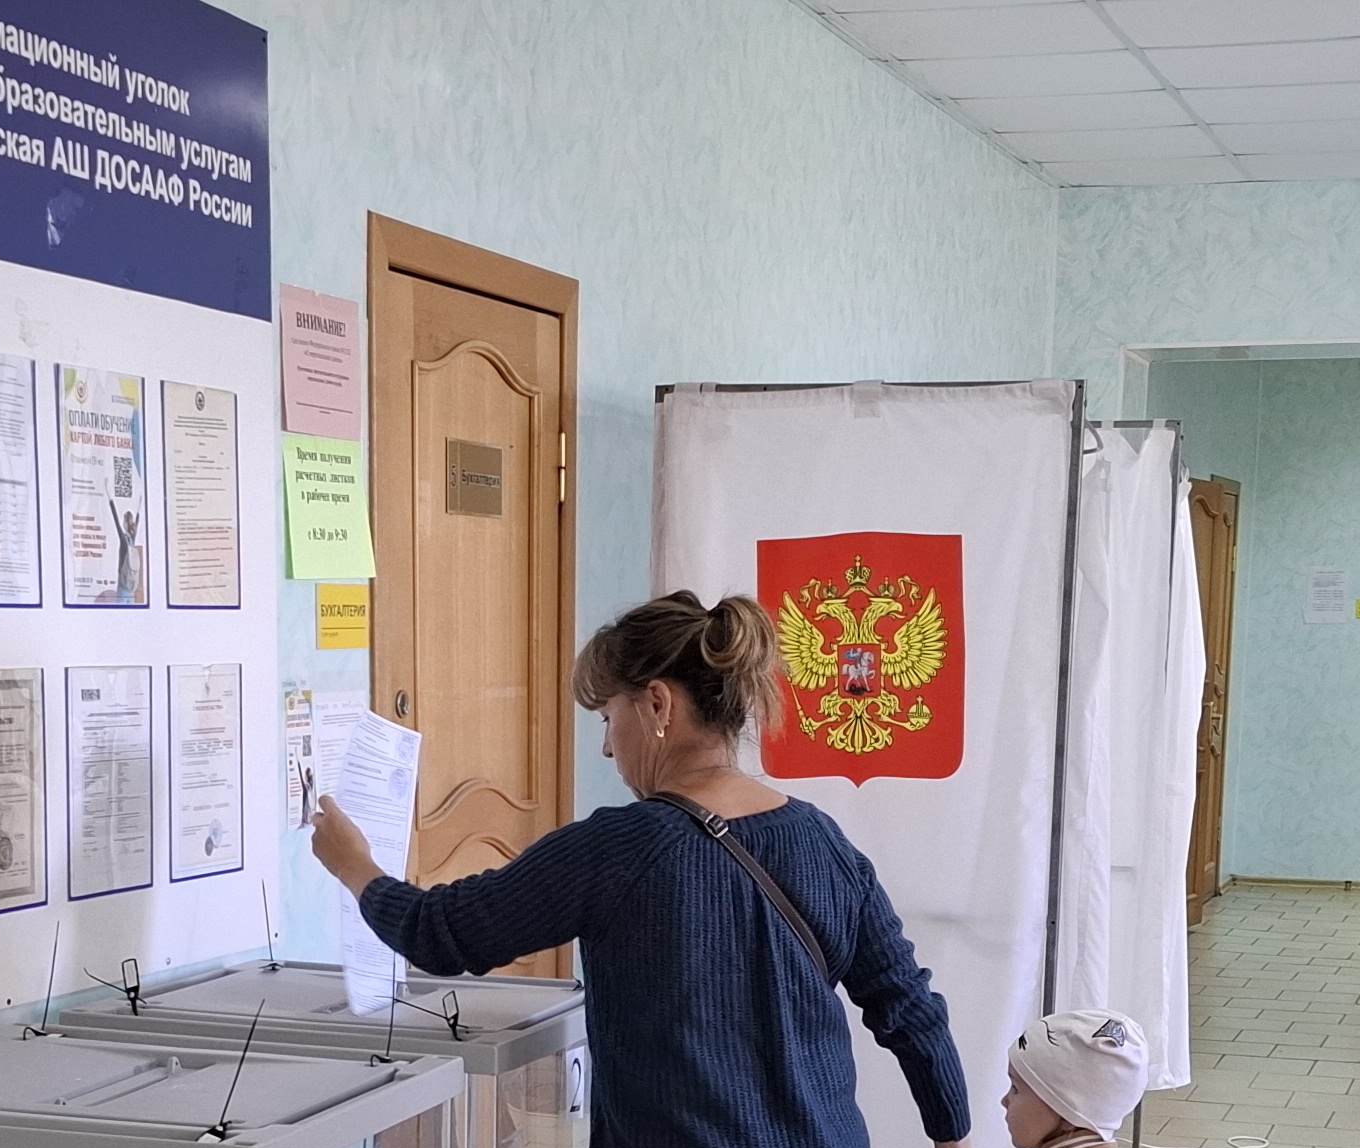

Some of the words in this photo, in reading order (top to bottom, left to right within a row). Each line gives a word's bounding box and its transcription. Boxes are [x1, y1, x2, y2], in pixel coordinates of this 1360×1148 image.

[124, 68, 190, 116] уголок
[51, 136, 90, 180] АШ
[95, 149, 184, 206] ДОСААФ
[189, 179, 252, 228] России
[180, 136, 252, 183] услугам
[296, 311, 346, 338] ВНИМАНИЕ!
[69, 409, 99, 429] ОПЛАТИ
[296, 447, 317, 464] Время
[570, 1057, 582, 1112] 2
